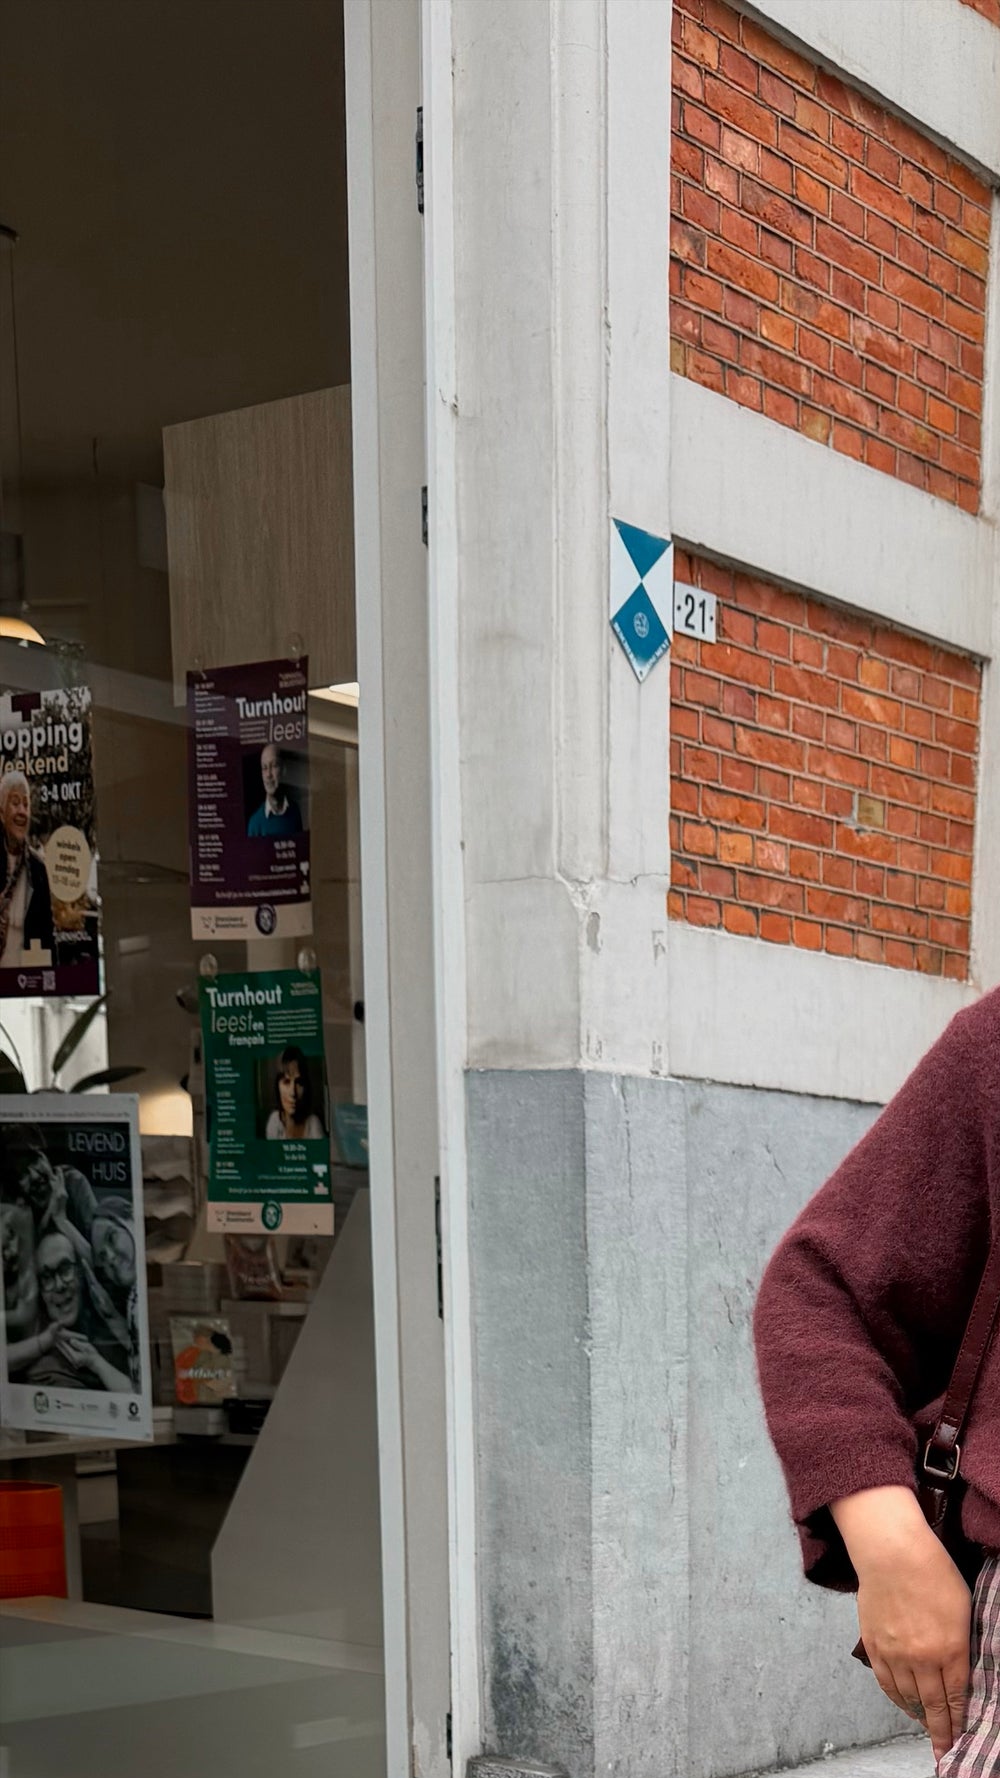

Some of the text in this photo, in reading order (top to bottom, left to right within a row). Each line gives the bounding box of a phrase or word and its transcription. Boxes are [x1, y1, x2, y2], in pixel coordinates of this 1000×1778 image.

[685, 594, 706, 634] 21
[236, 690, 306, 719] Turnhout
[41, 782, 82, 802] 3-4 OKT
[59, 852, 77, 863] open
[205, 984, 282, 1008] Turnhout
[211, 1009, 253, 1033] leest
[252, 1022, 265, 1031] en
[228, 1032, 265, 1048] français
[68, 1132, 126, 1152] LEVEND
[91, 1162, 127, 1181] HUIS
